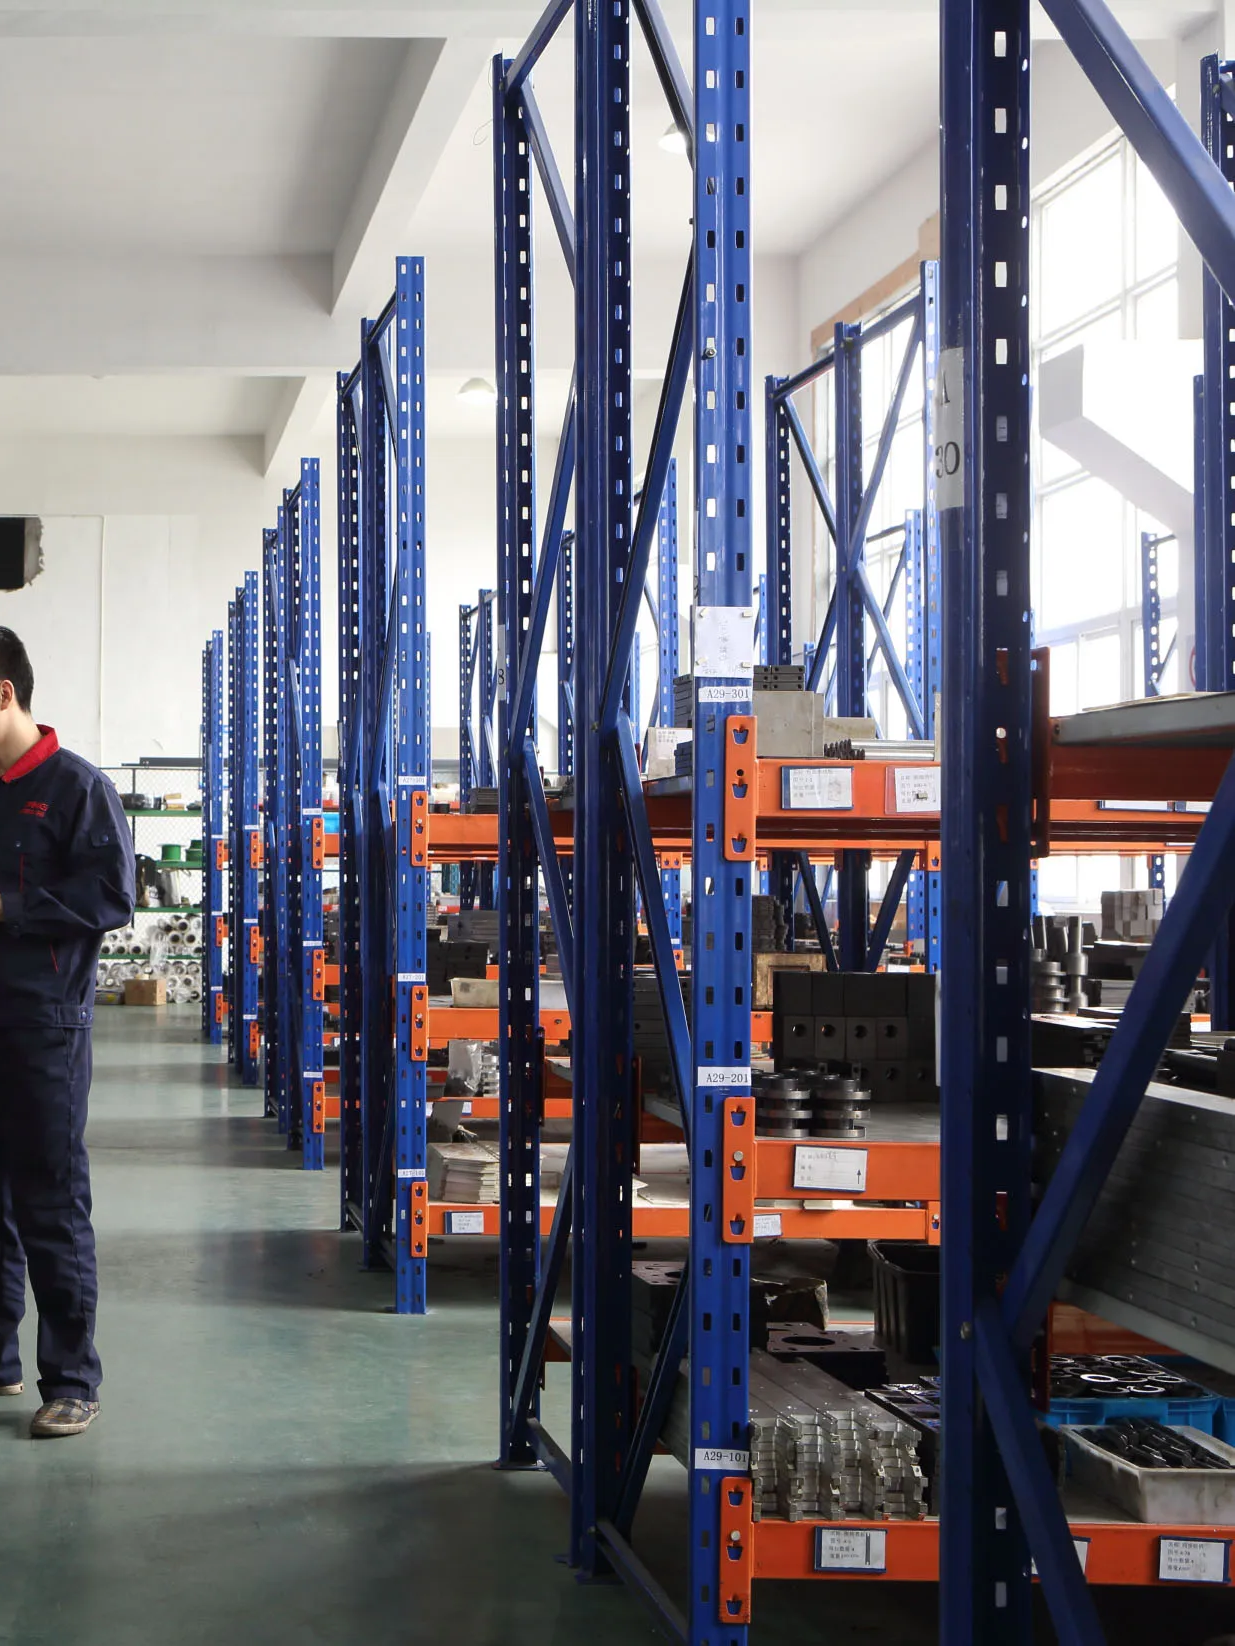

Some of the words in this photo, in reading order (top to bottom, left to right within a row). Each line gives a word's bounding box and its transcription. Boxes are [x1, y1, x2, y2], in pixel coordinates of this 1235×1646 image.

[935, 441, 961, 479] 30
[706, 688, 750, 700] A29-301
[706, 1073, 749, 1083] A29-201
[703, 1450, 747, 1463] A29-101
